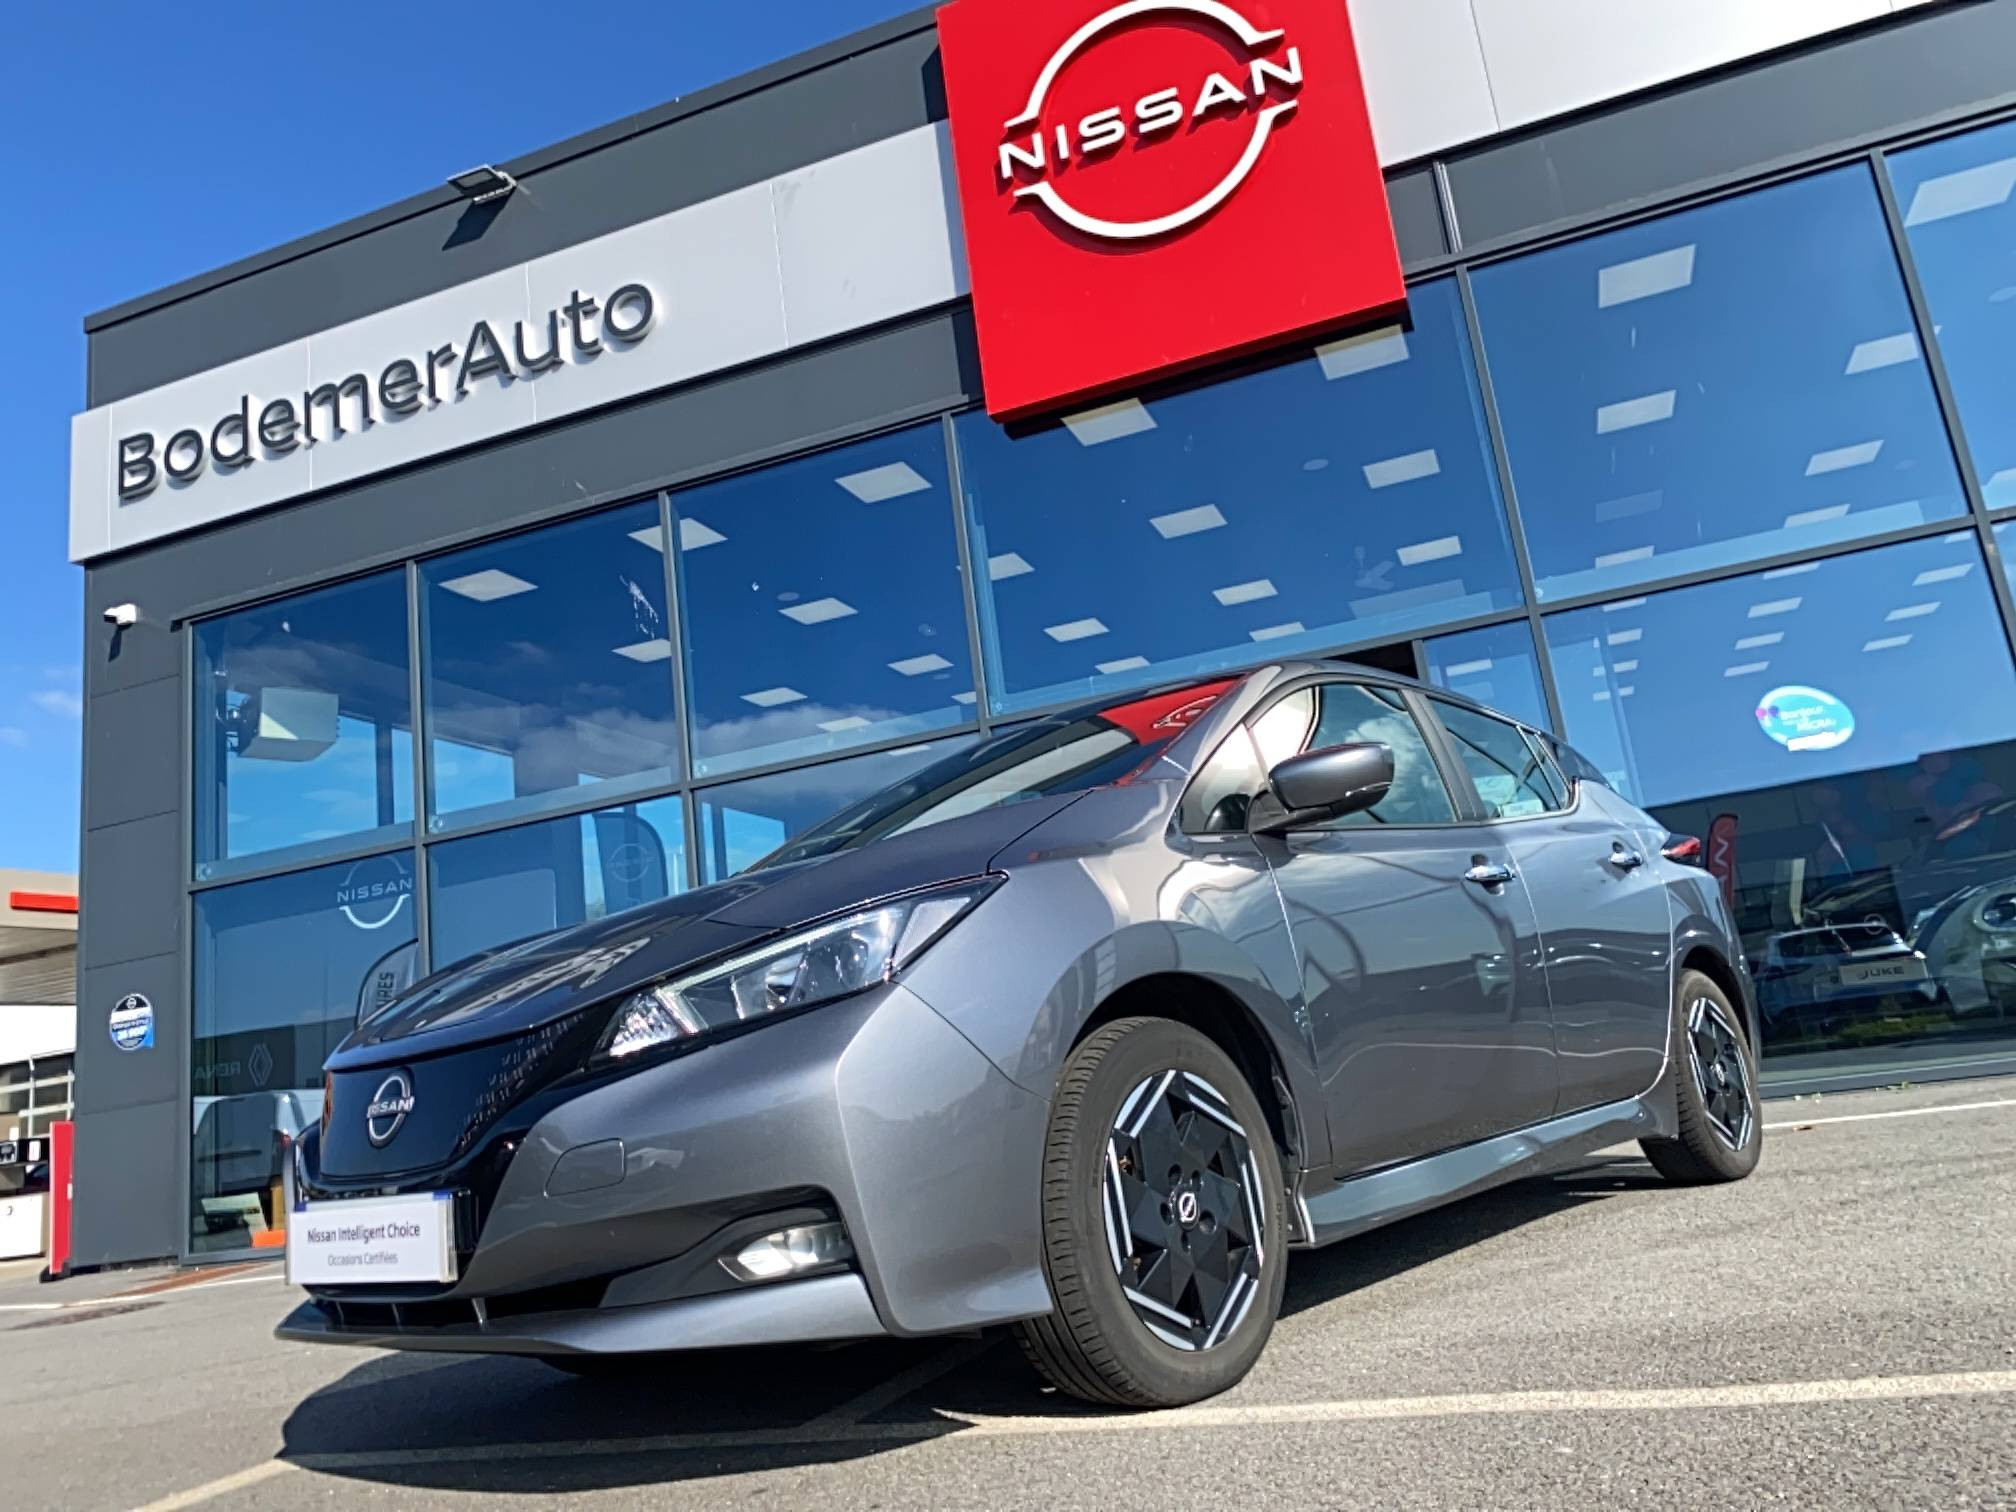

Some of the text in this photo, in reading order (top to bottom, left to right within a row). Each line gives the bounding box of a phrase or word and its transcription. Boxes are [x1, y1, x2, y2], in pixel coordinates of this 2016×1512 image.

[998, 47, 1303, 178] NISSAN
[117, 283, 655, 499] BodemerAuto
[336, 878, 413, 903] NISSAN
[1857, 966, 1905, 980] JUKE
[307, 1221, 421, 1244] Nissan Intelligent Choice
[328, 1253, 363, 1267] Occasions
